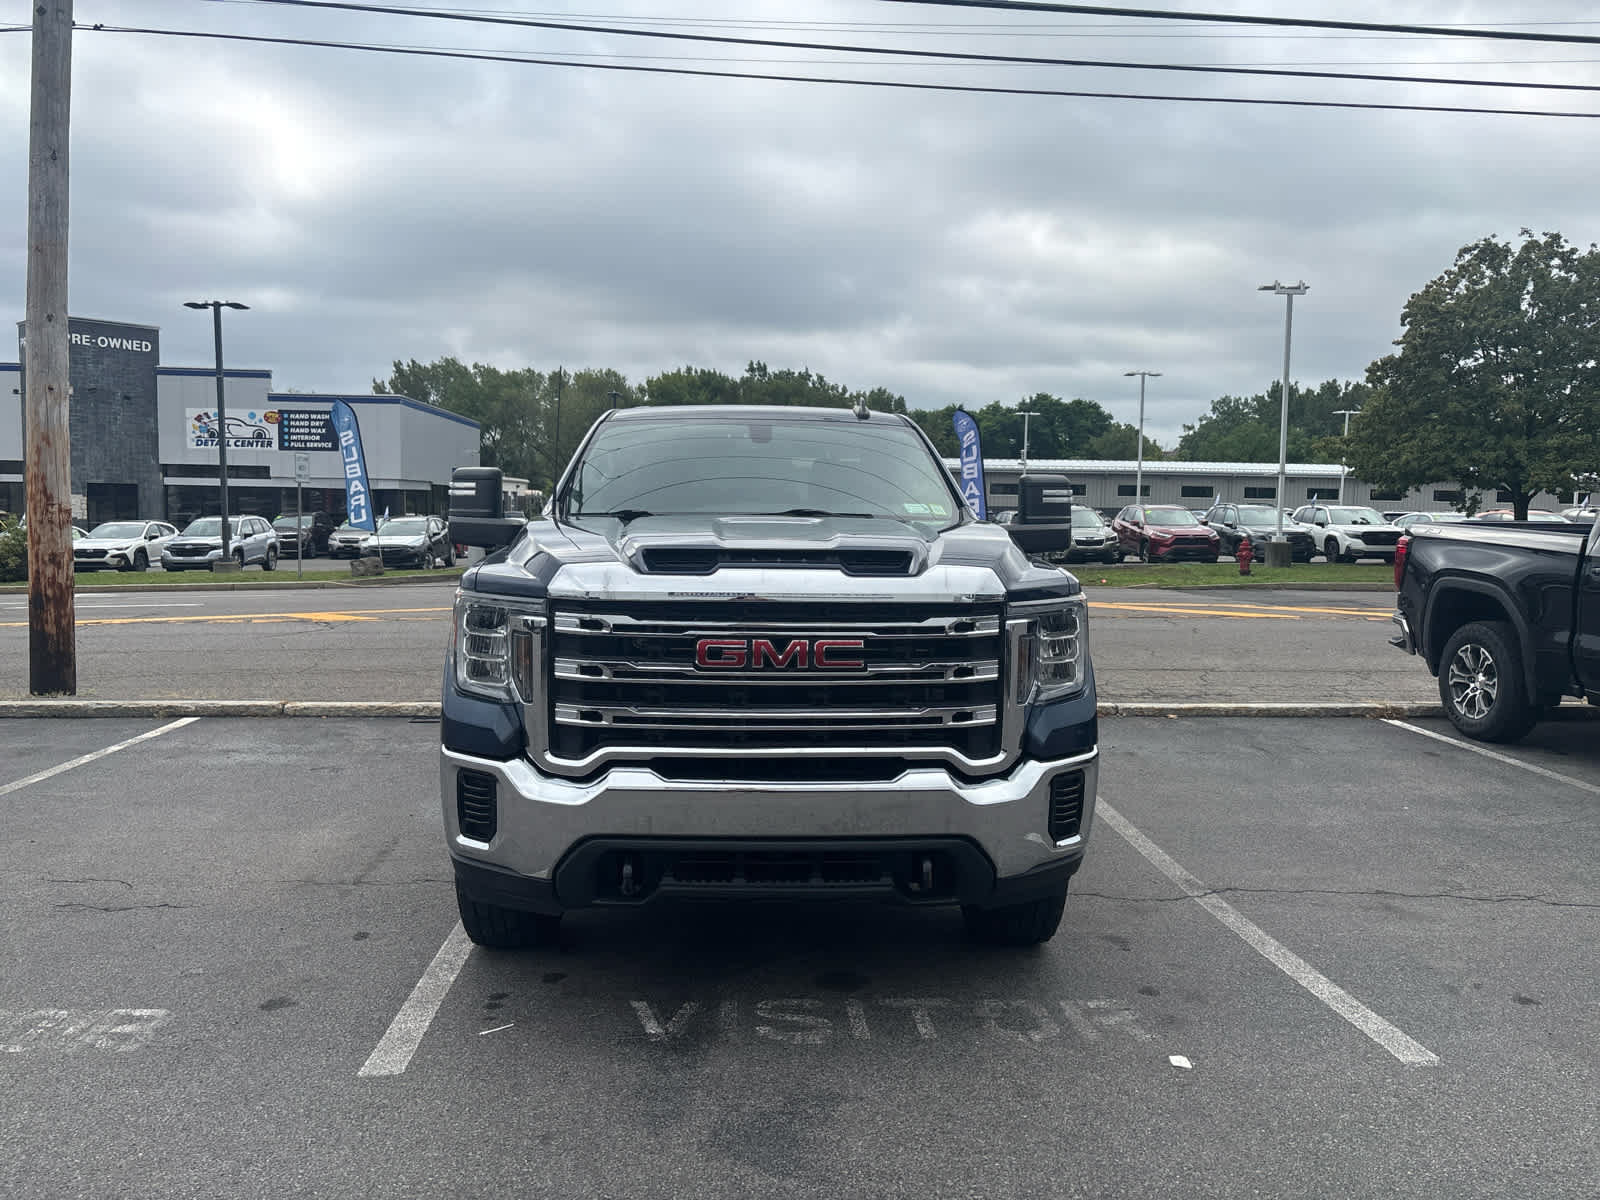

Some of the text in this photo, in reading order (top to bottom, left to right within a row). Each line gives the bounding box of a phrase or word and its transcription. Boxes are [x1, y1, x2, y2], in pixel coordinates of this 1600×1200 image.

[67, 333, 152, 352] RE-OWNED
[195, 439, 273, 448] DETAL CENTER
[696, 639, 864, 669] GMC
[628, 995, 1162, 1044] VISITOR
